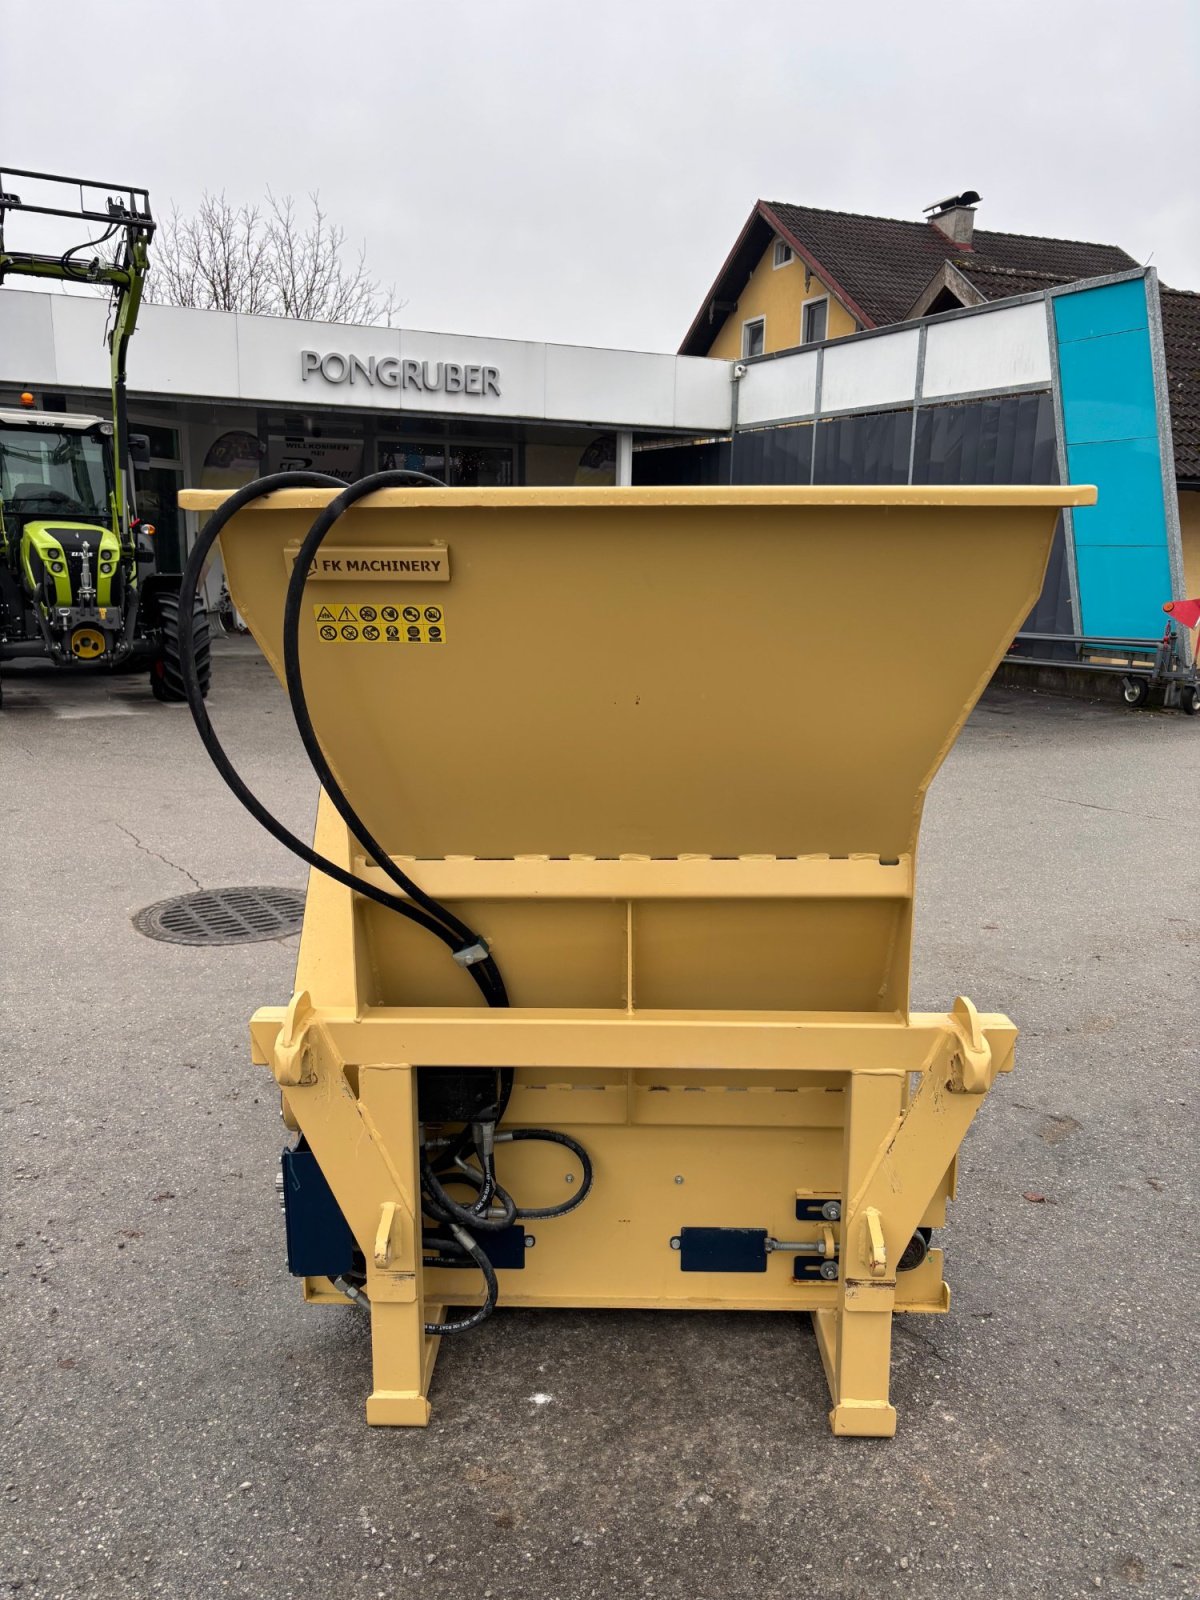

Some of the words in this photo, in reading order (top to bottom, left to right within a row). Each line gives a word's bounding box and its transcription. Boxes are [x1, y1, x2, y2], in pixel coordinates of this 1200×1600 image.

[301, 350, 500, 396] PONGRUBER
[323, 560, 342, 571] FK
[347, 560, 440, 572] MACHINERY
